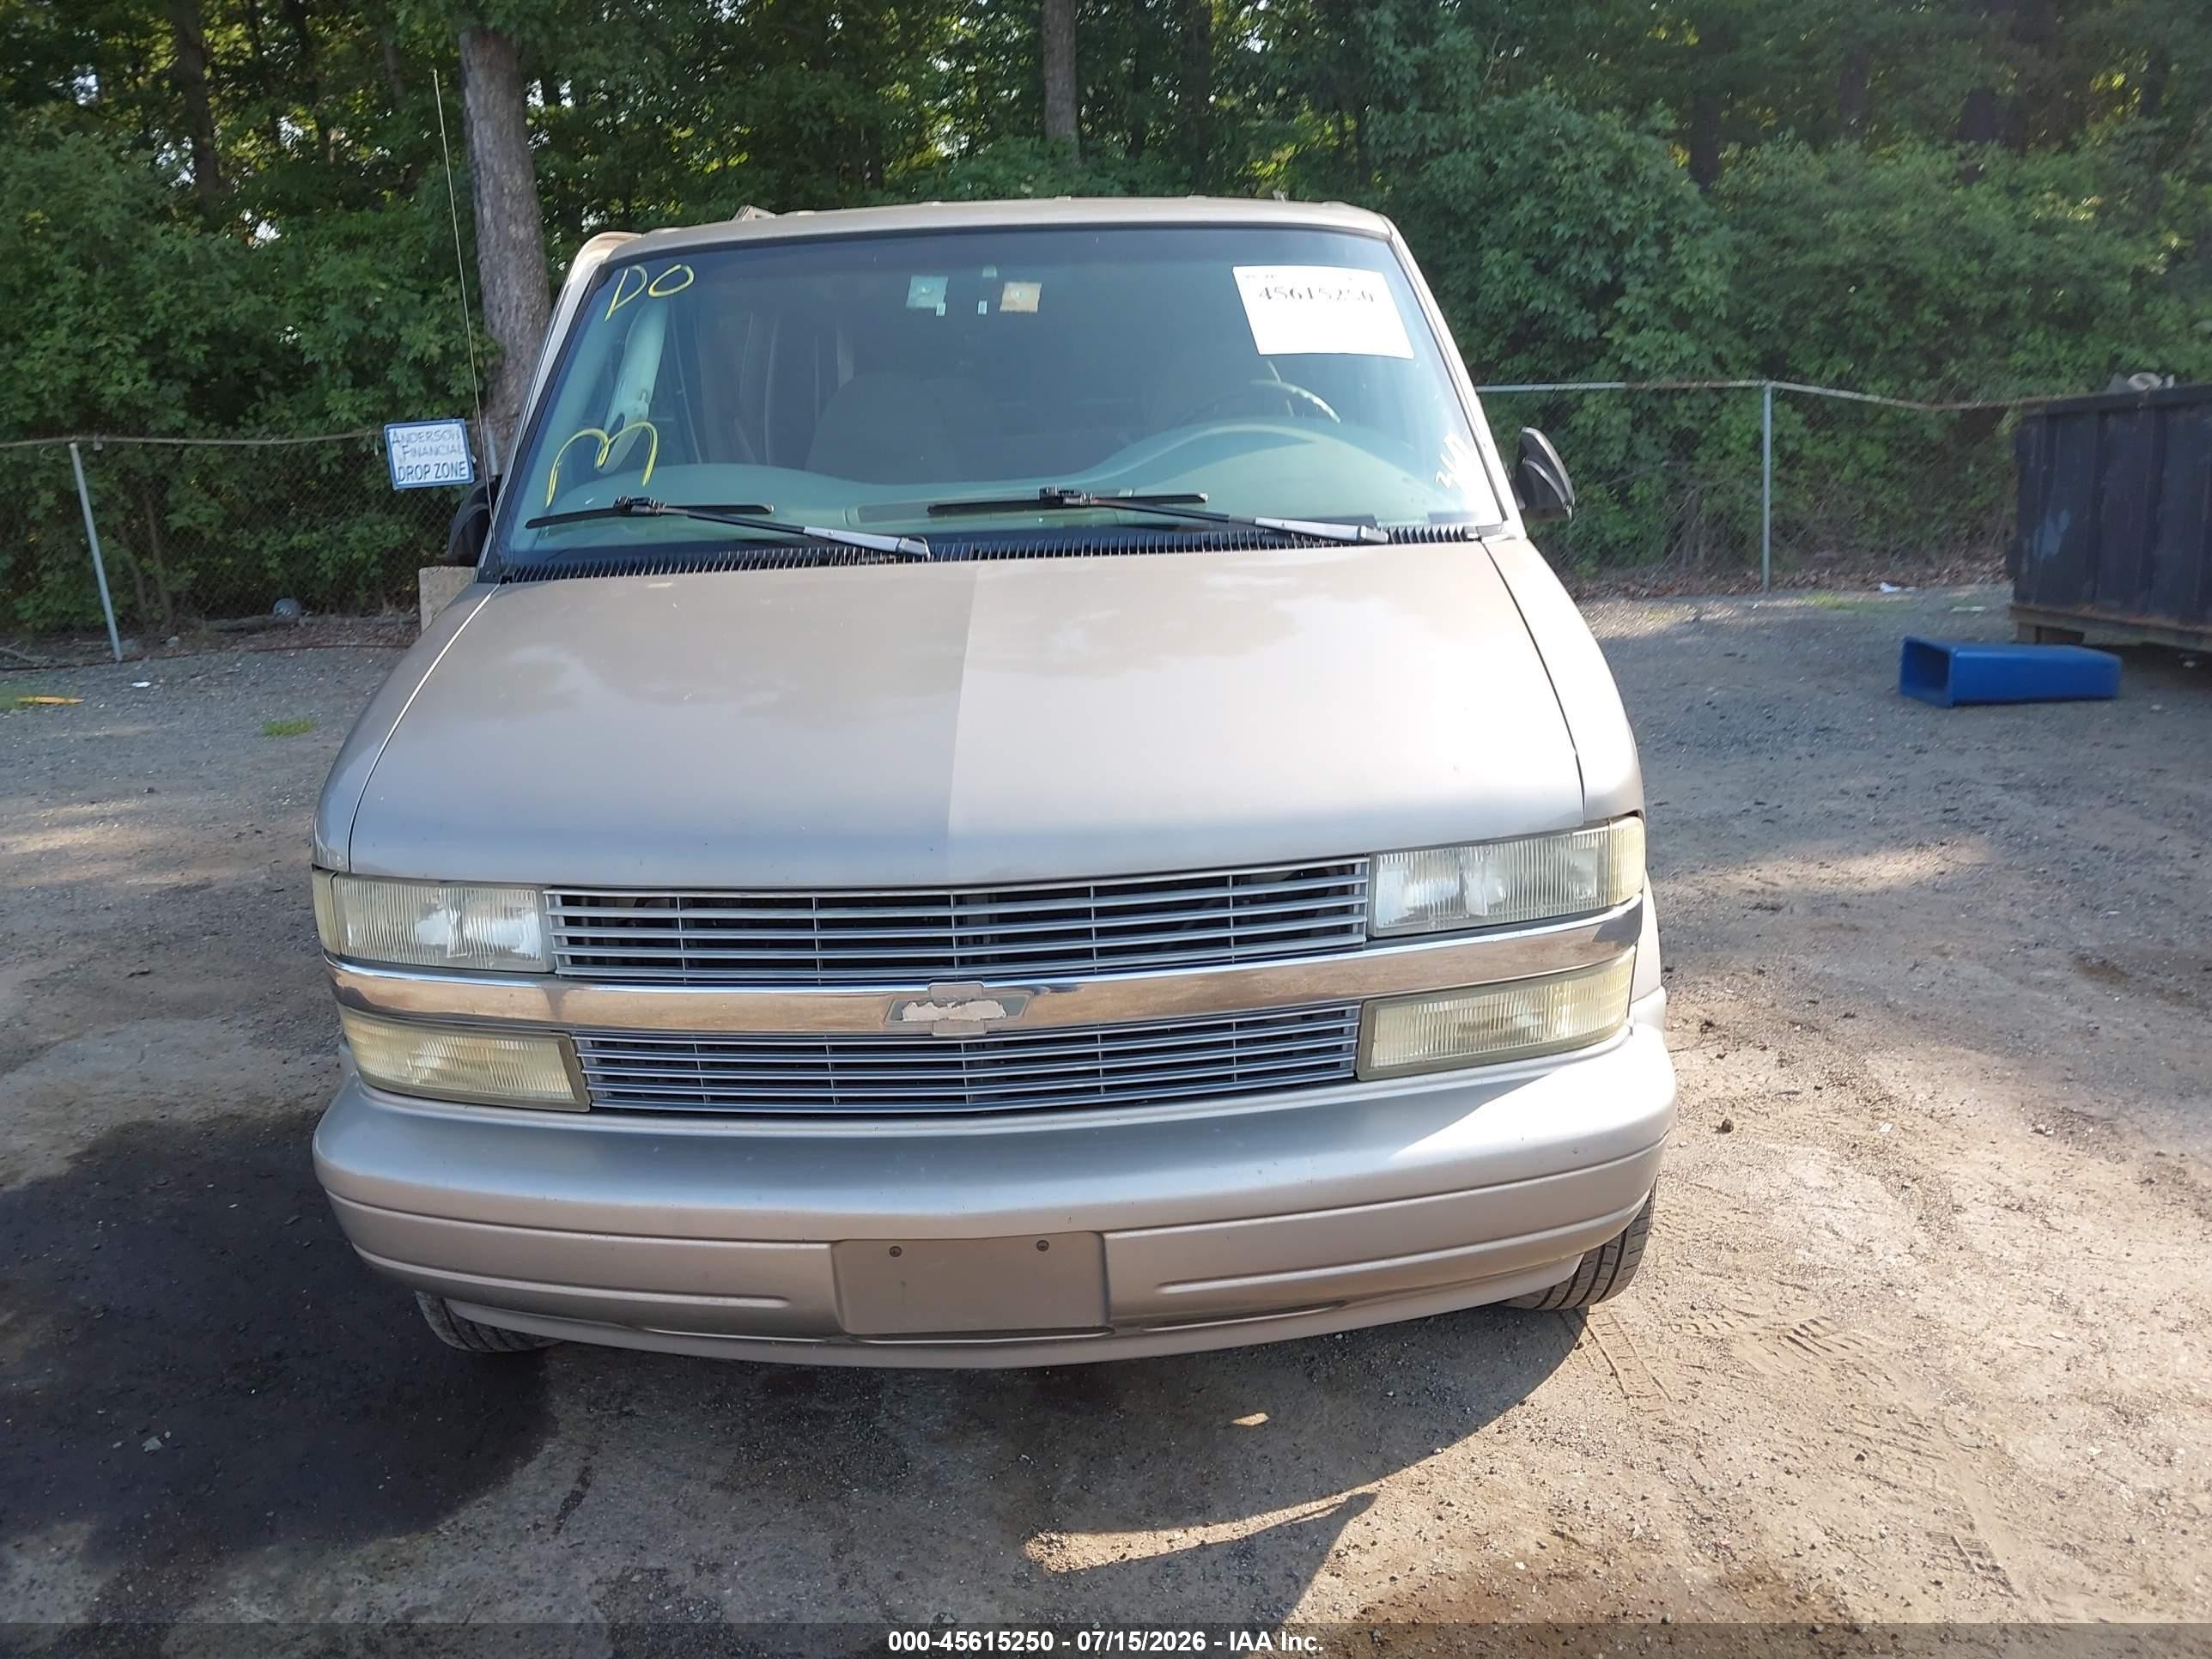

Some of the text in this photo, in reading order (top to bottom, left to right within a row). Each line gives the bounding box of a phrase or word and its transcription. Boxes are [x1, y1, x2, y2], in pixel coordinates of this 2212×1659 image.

[392, 429, 460, 444] ANDERSON
[402, 444, 465, 460] FINANCIAL
[398, 461, 466, 482] DROP ZONE
